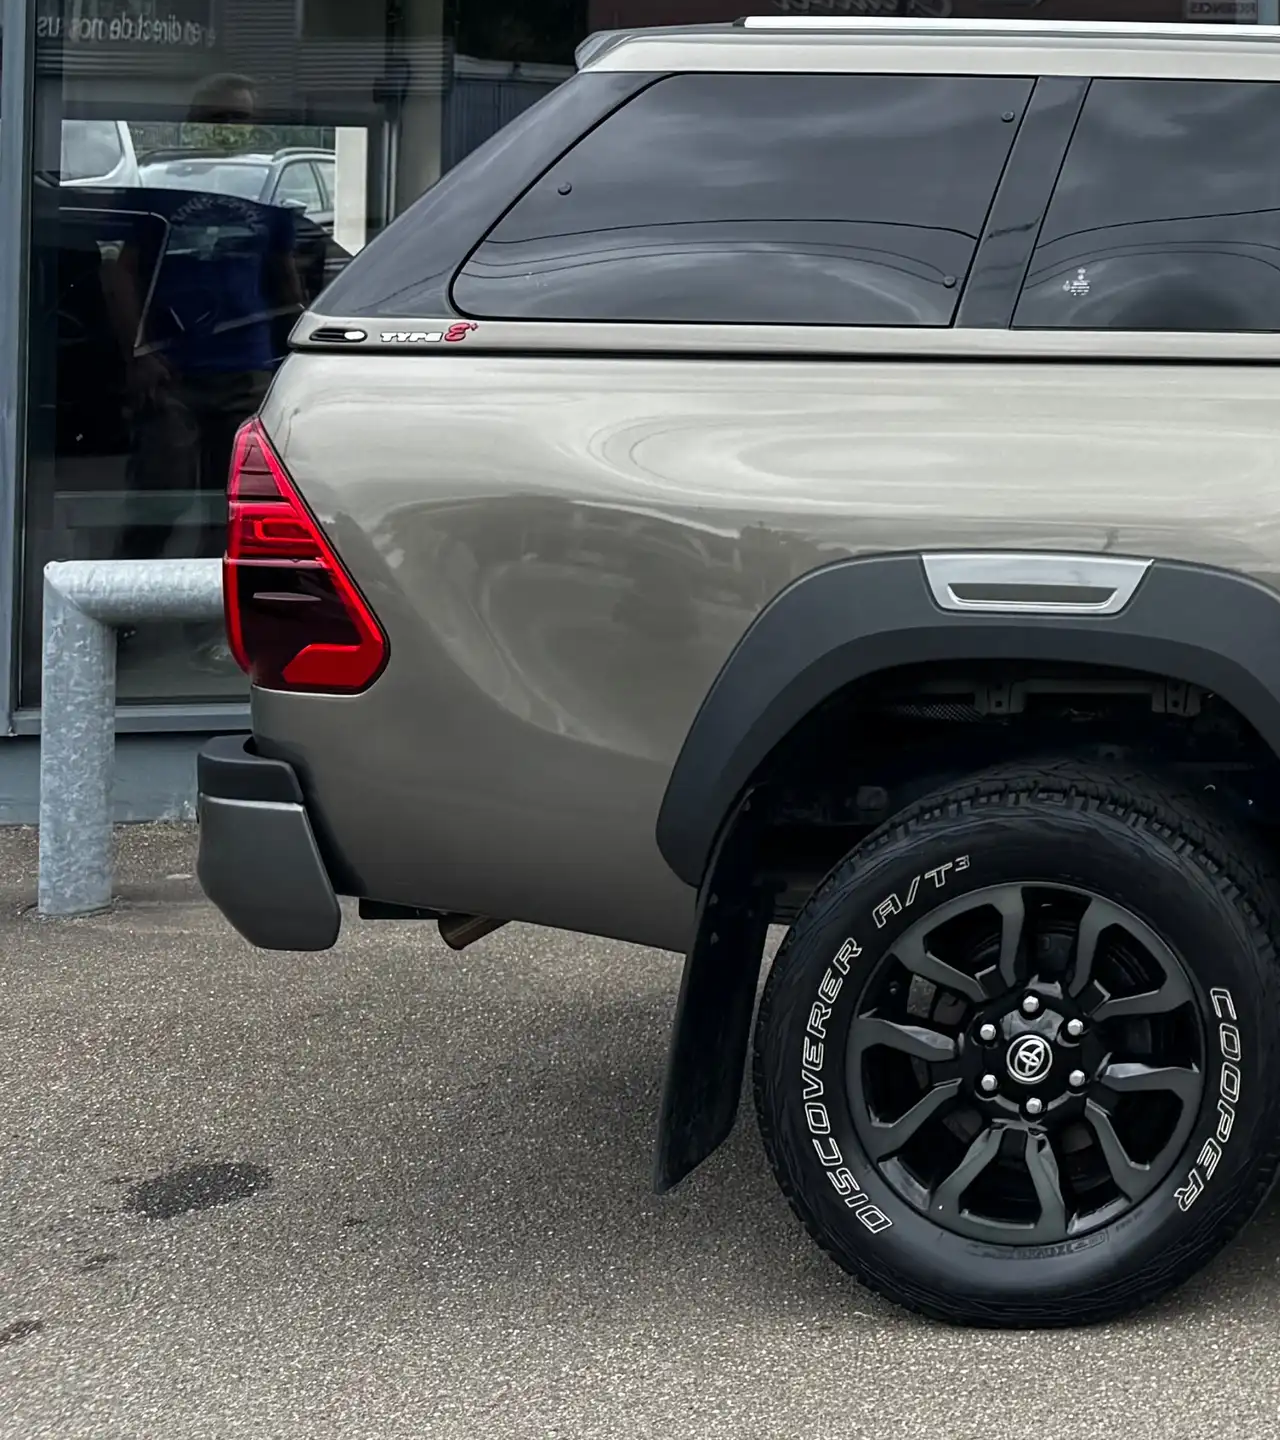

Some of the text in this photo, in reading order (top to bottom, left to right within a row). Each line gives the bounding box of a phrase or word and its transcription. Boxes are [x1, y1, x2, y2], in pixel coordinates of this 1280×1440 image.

[380, 331, 443, 343] TYPE
[803, 937, 893, 1234] DISCOVERER
[1173, 987, 1242, 1212] COOPER
